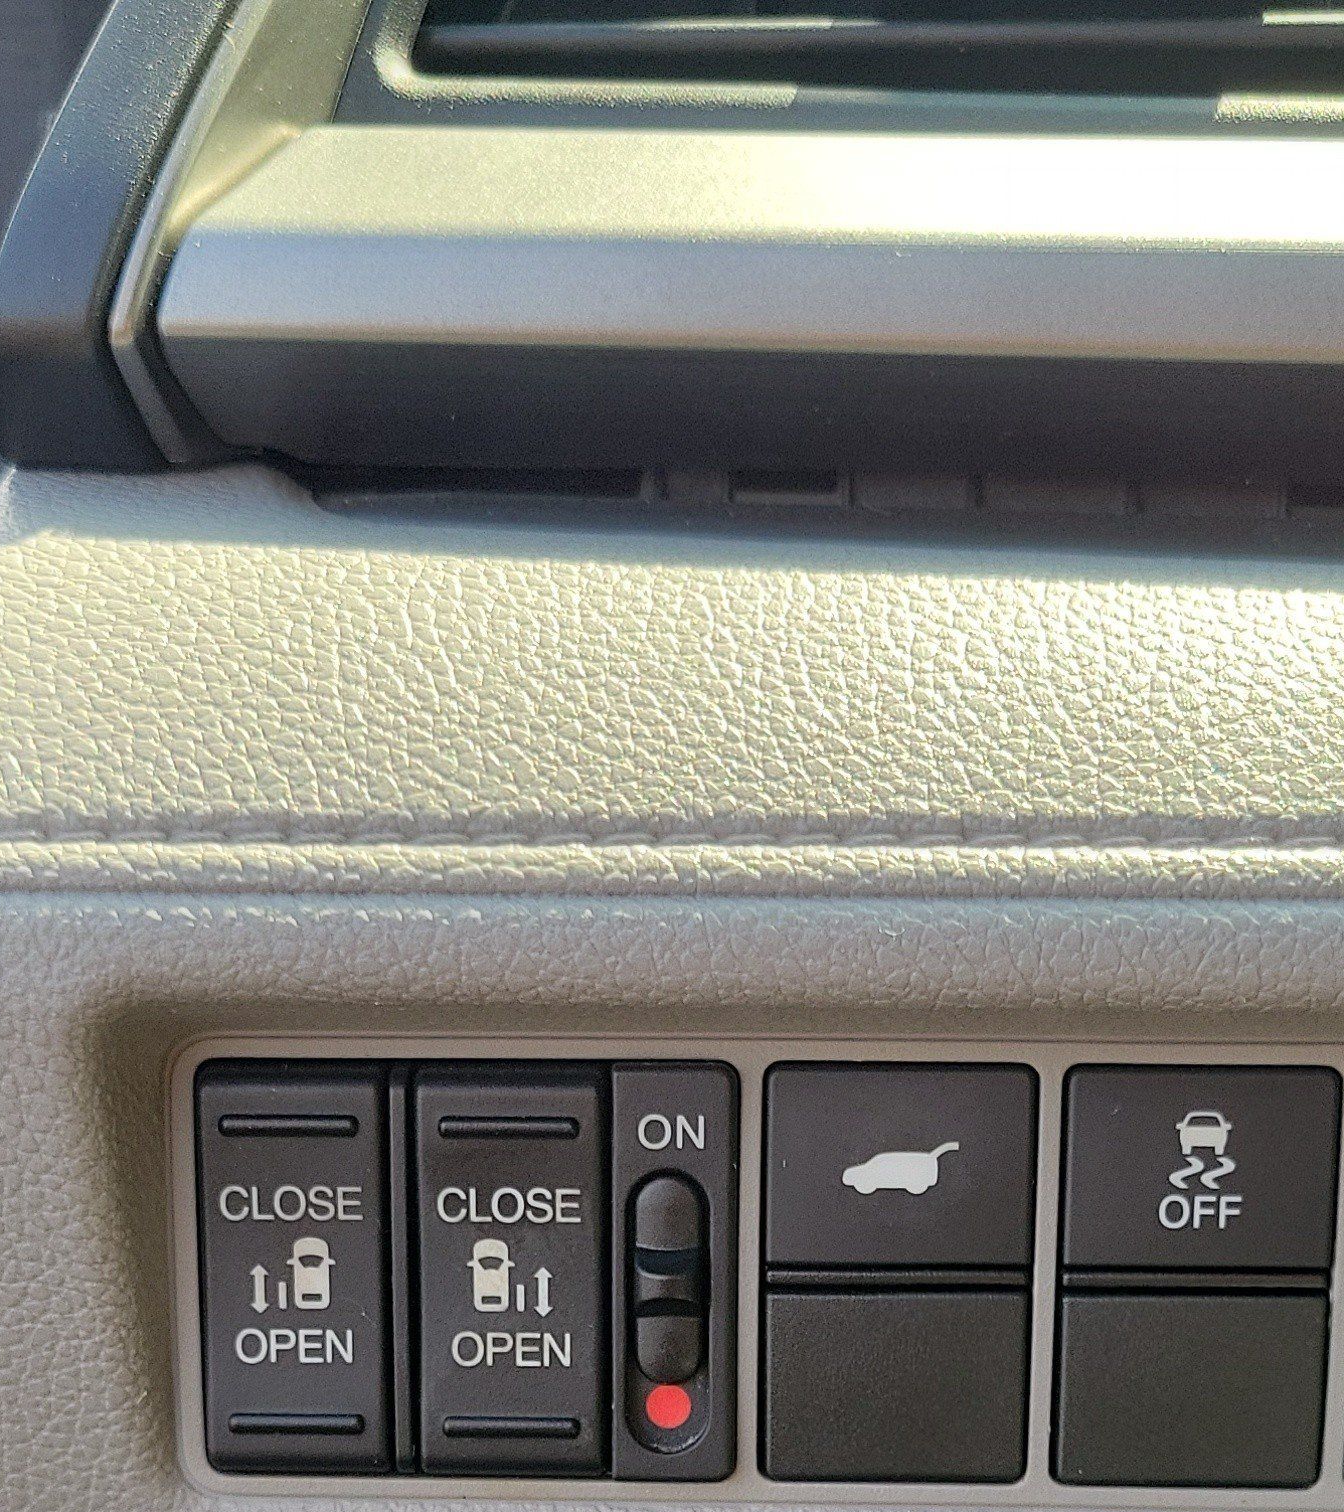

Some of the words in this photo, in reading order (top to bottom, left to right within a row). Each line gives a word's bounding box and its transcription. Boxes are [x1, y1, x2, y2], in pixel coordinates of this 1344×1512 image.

[637, 1113, 705, 1150] ON
[219, 1185, 363, 1222] CLOSE
[436, 1187, 581, 1224] CLOSE
[1158, 1194, 1242, 1229] OFF
[235, 1328, 353, 1364] OPEN
[451, 1331, 571, 1367] OPEN
